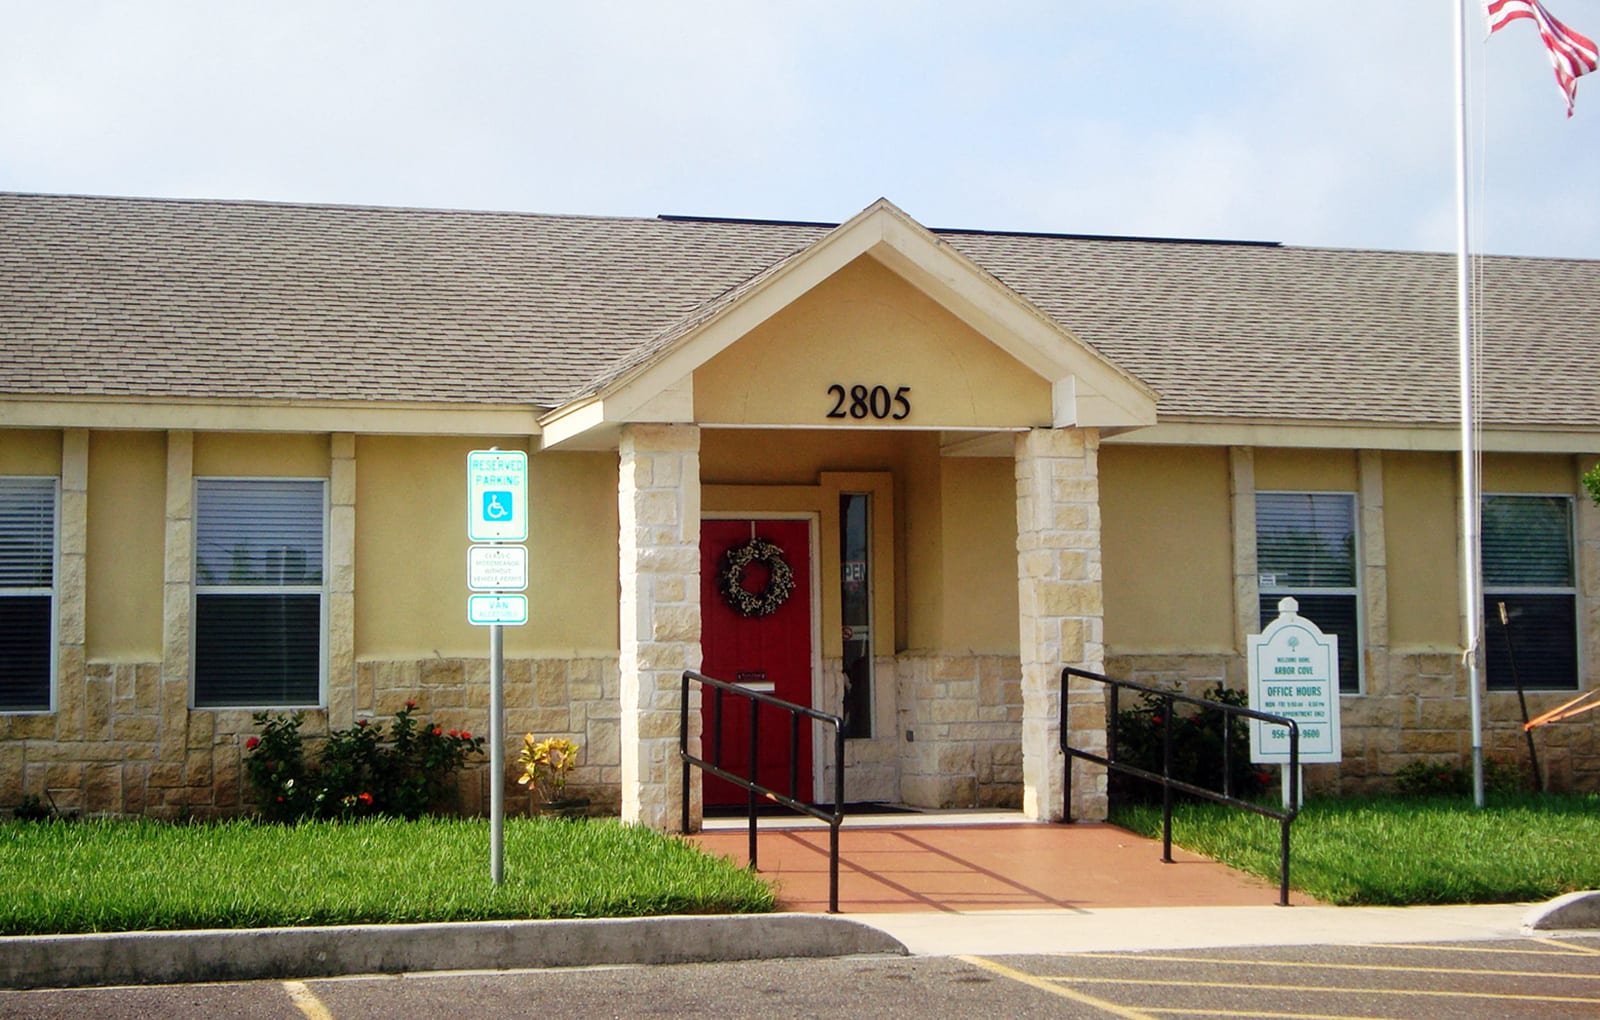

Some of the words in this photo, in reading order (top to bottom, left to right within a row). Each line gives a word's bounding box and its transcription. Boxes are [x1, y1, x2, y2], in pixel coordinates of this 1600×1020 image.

[826, 384, 911, 420] 2805
[473, 460, 522, 471] RESERVED
[476, 475, 520, 486] PARKING
[489, 601, 509, 609] VAN
[1274, 666, 1295, 675] ARBOR
[1298, 666, 1313, 675] COVE
[1267, 686, 1293, 697] OFFICE
[1296, 686, 1322, 697] HOURS
